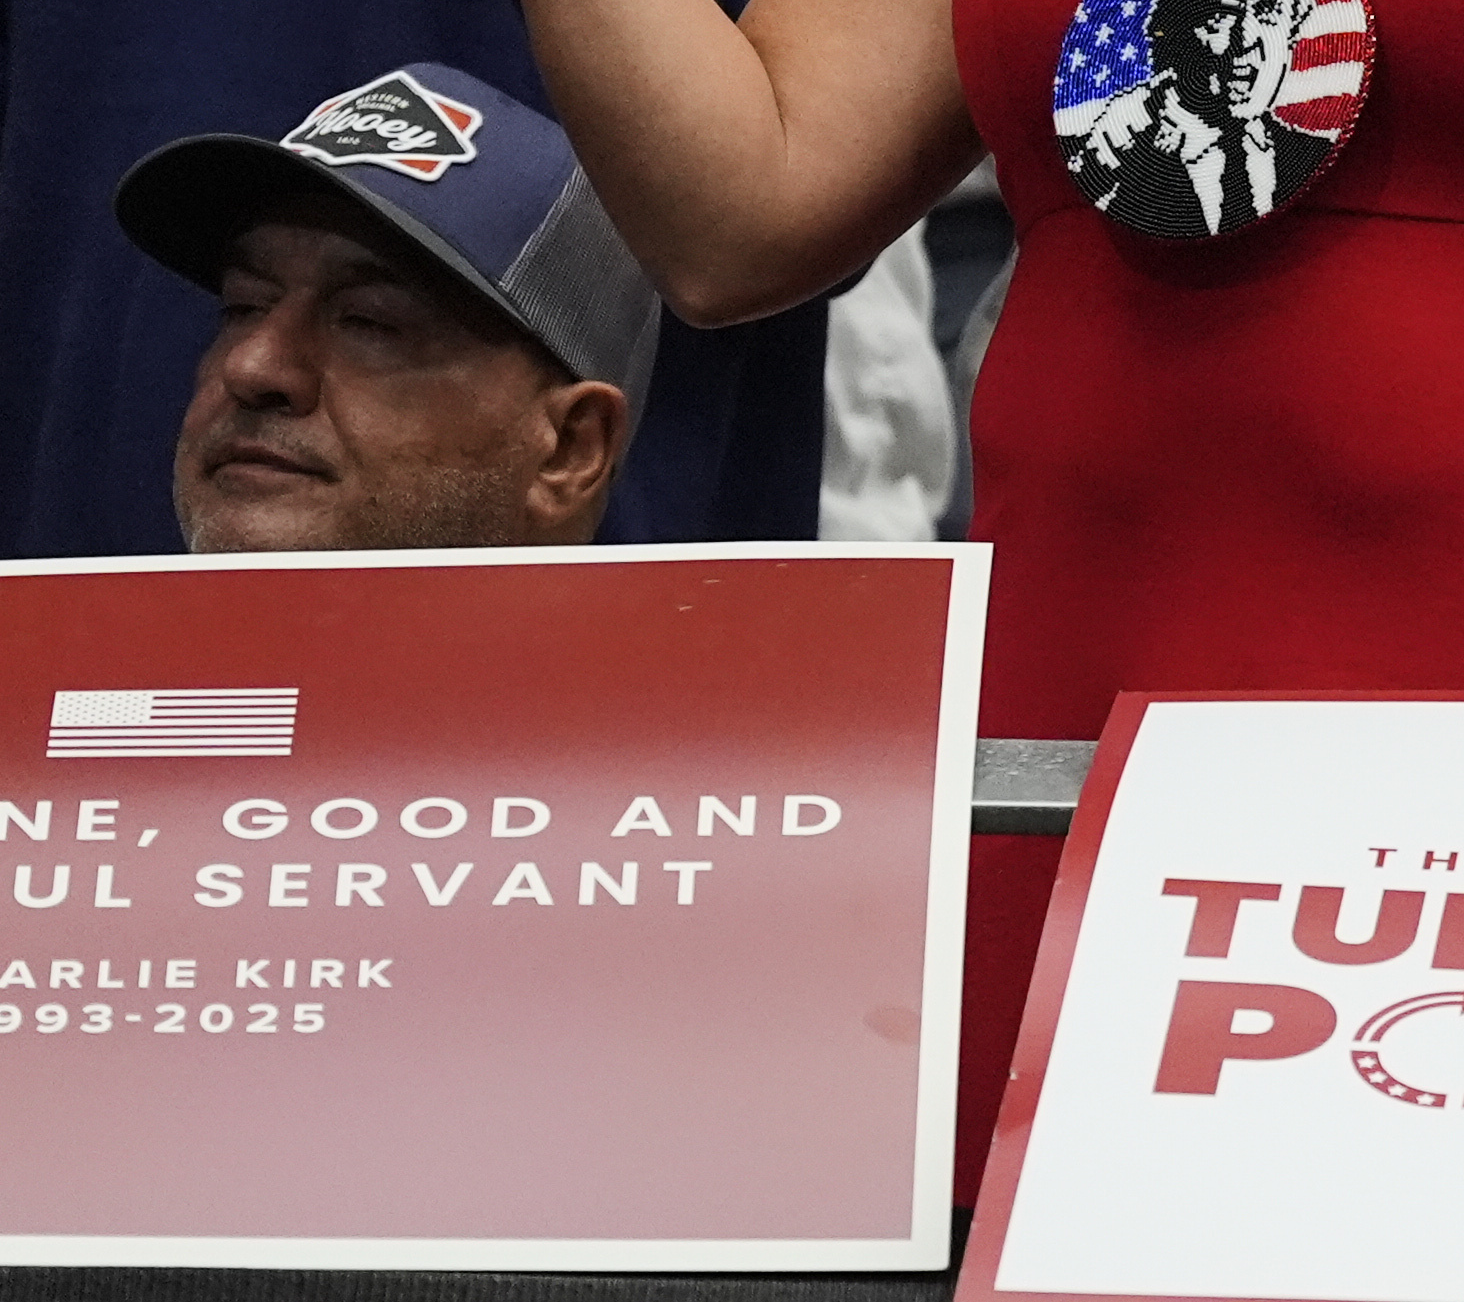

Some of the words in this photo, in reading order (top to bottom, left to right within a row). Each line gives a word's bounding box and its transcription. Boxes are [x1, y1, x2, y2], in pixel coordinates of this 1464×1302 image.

[304, 105, 438, 152] Hooey
[0, 799, 160, 848] NE,
[222, 796, 552, 841] GOOD
[610, 793, 843, 838] AND
[193, 859, 714, 909] SERVANT
[0, 958, 198, 989] ARLIE
[235, 958, 394, 989] KIRK
[0, 1002, 326, 1035] 993-2025
